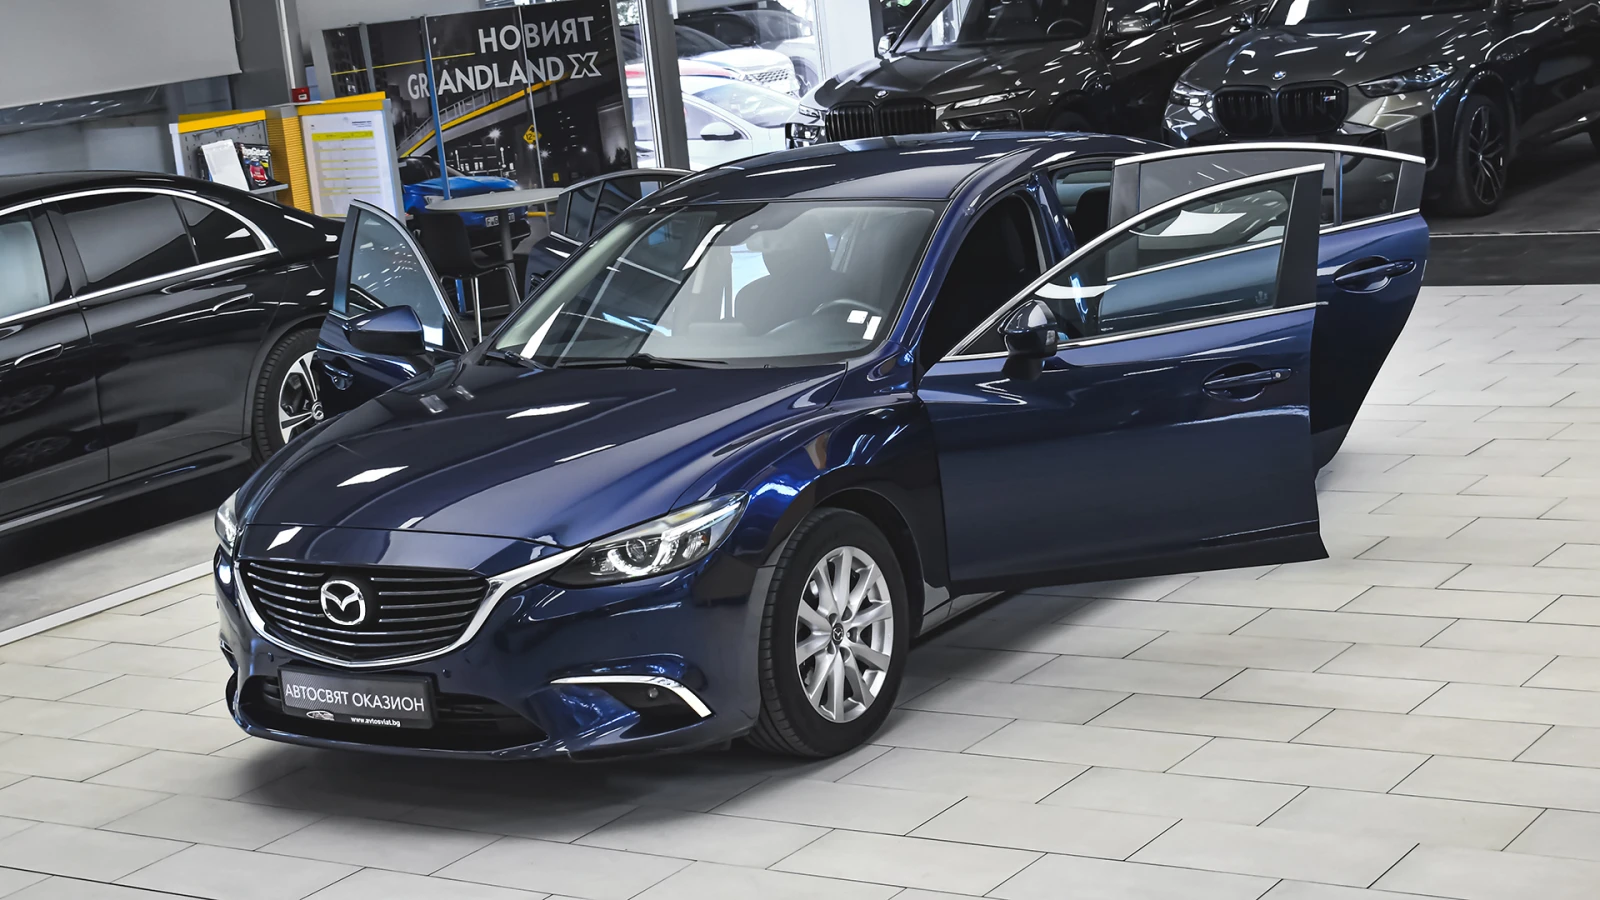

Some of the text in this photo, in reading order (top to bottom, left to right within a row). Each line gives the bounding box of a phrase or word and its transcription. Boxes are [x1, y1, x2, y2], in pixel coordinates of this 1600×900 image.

[478, 16, 594, 53] НОВИЯТ
[407, 51, 602, 100] GRANDLAND X
[285, 684, 425, 712] АВТОСВЯТ ОКАЗИОН
[350, 716, 401, 728] www.avtosviat.bg
